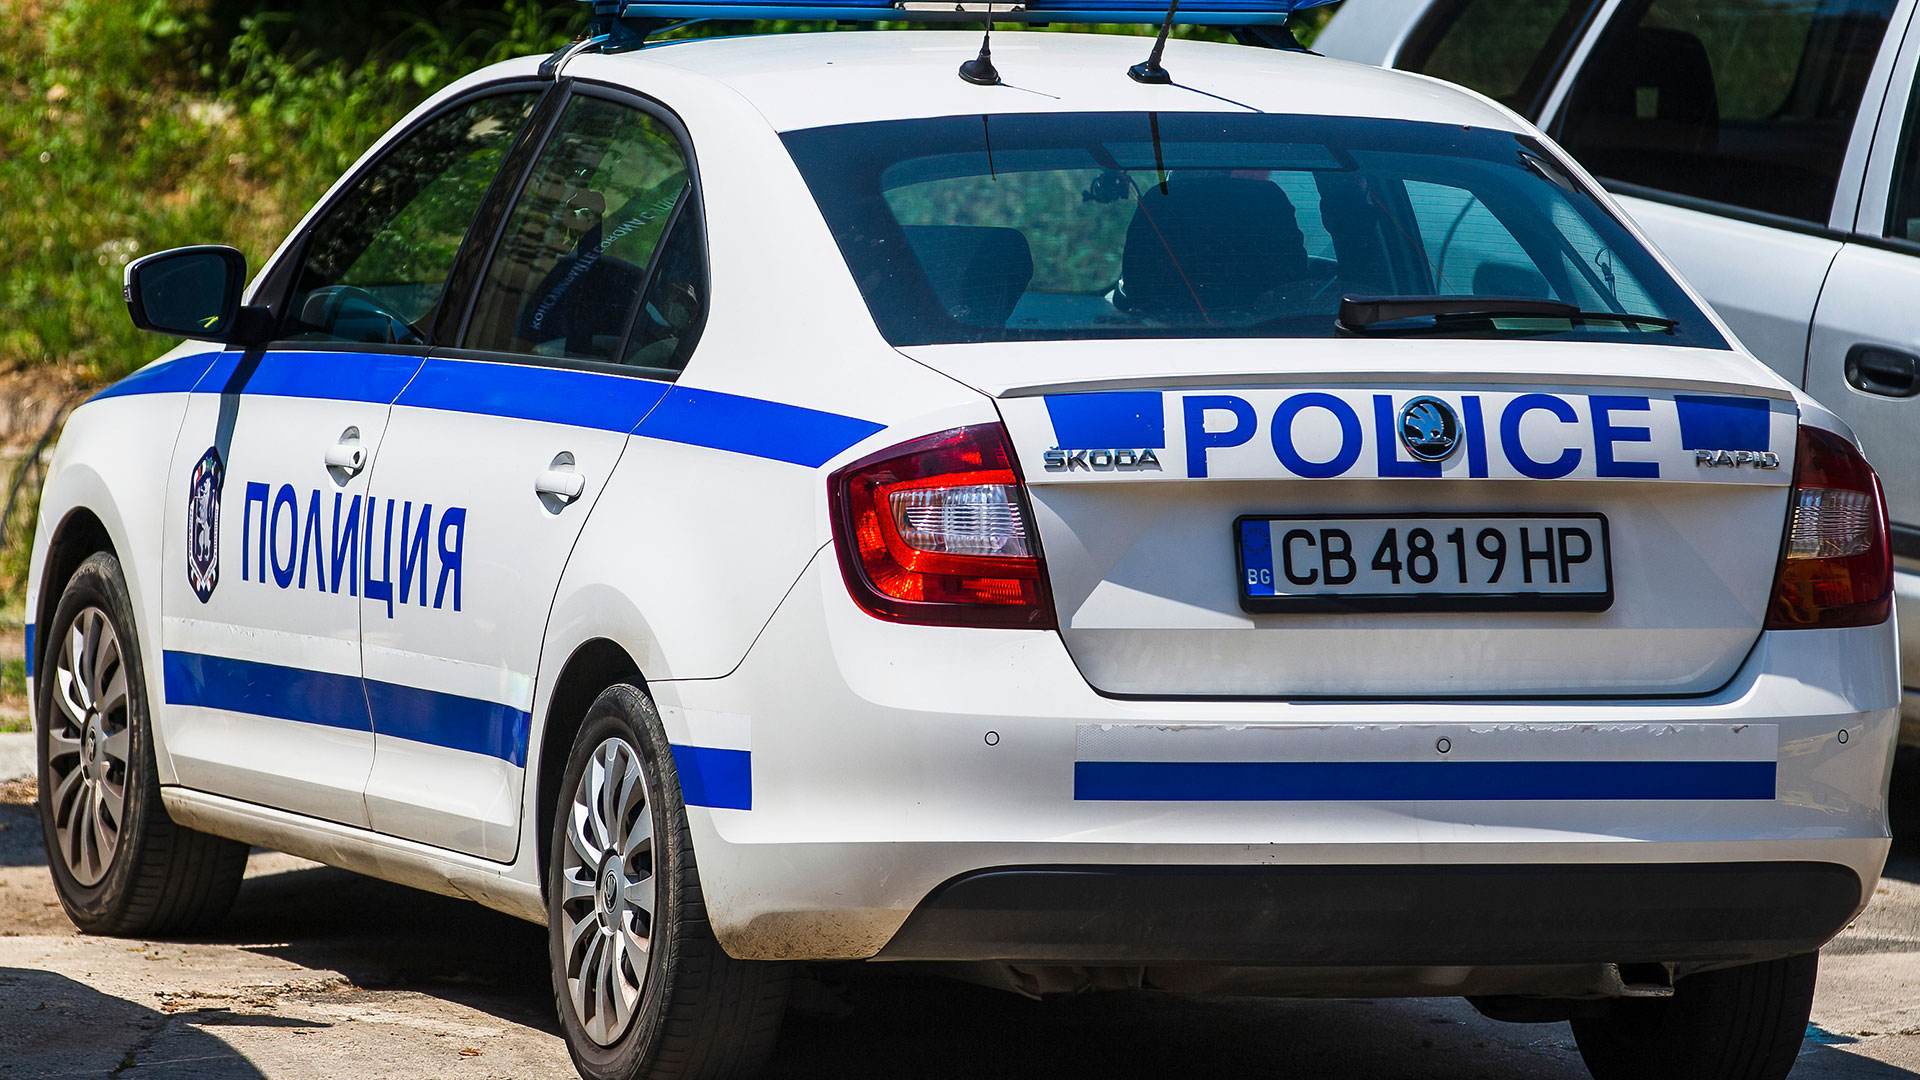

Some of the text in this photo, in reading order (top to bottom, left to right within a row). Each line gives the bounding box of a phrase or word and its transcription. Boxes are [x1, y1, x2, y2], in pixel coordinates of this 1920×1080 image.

[1182, 392, 1660, 480] POLICE
[1043, 446, 1163, 472] ŠKODA
[1694, 449, 1780, 469] RAPID
[242, 481, 467, 619] ПОЛИЦИЯ
[1282, 526, 1593, 585] CB 4819 HP
[1247, 569, 1271, 585] BG
